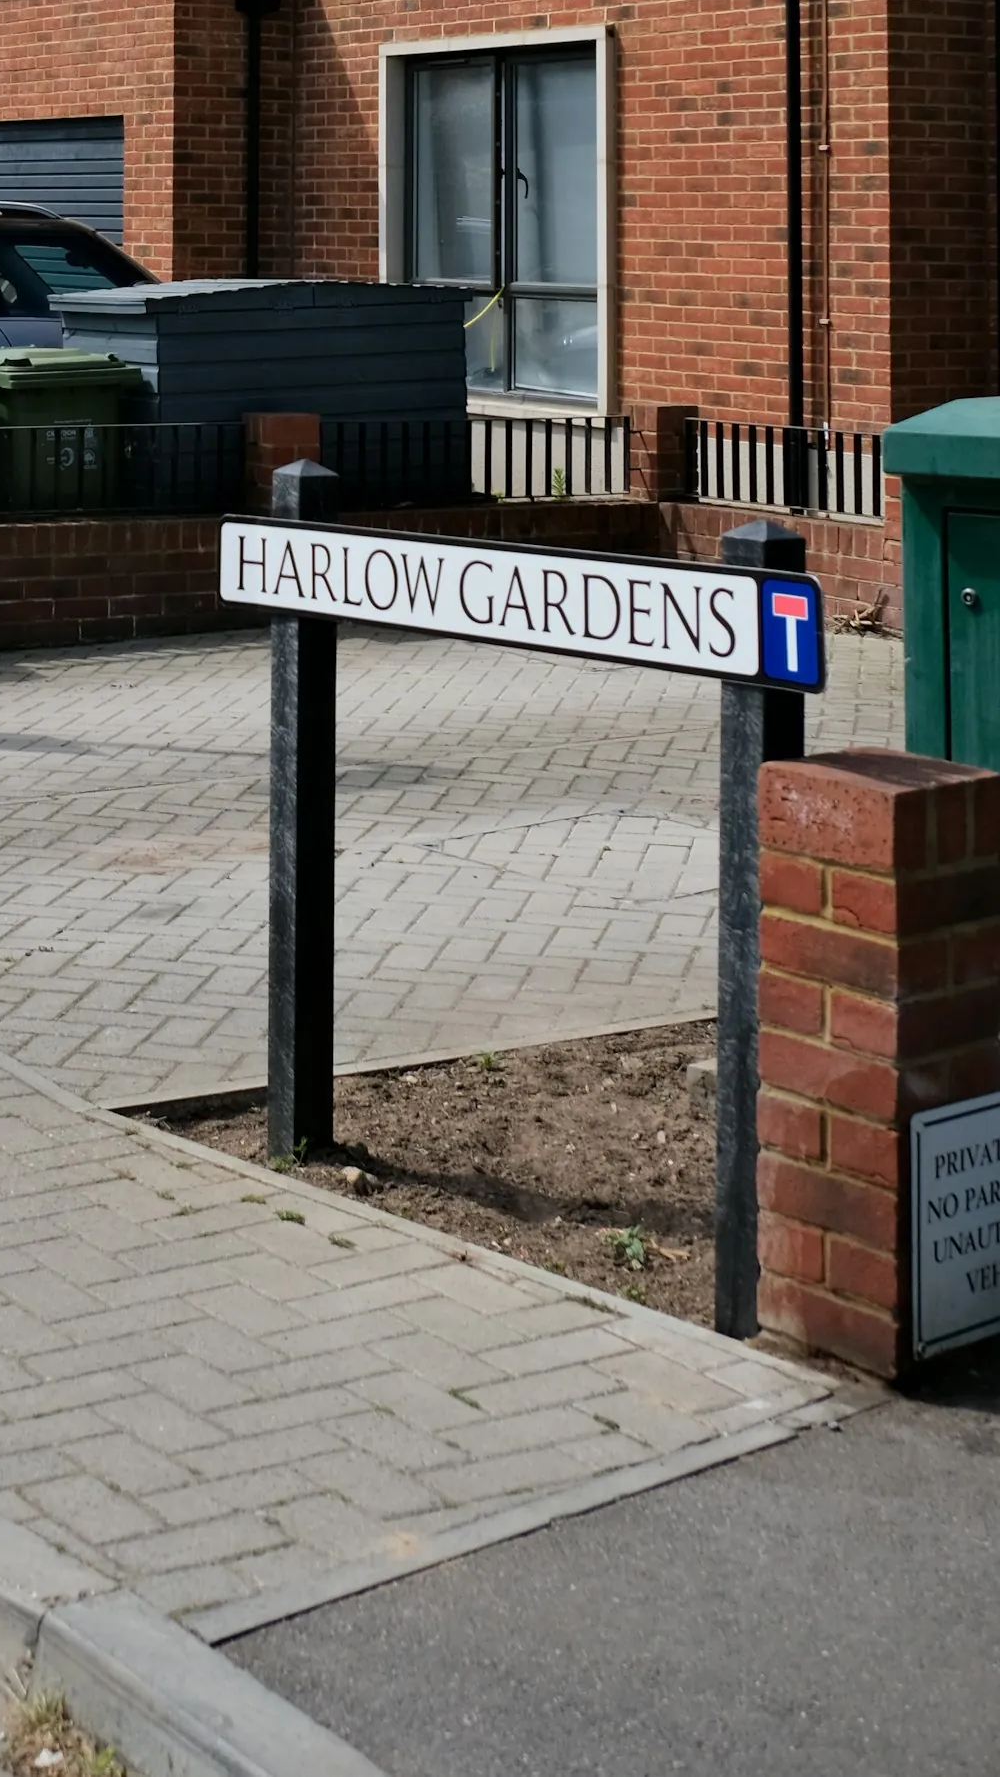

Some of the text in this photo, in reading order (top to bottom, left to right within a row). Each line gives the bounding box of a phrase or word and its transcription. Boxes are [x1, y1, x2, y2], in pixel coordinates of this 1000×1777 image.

[236, 535, 736, 658] HARLOW GARDENS
[926, 1191, 960, 1224] NO
